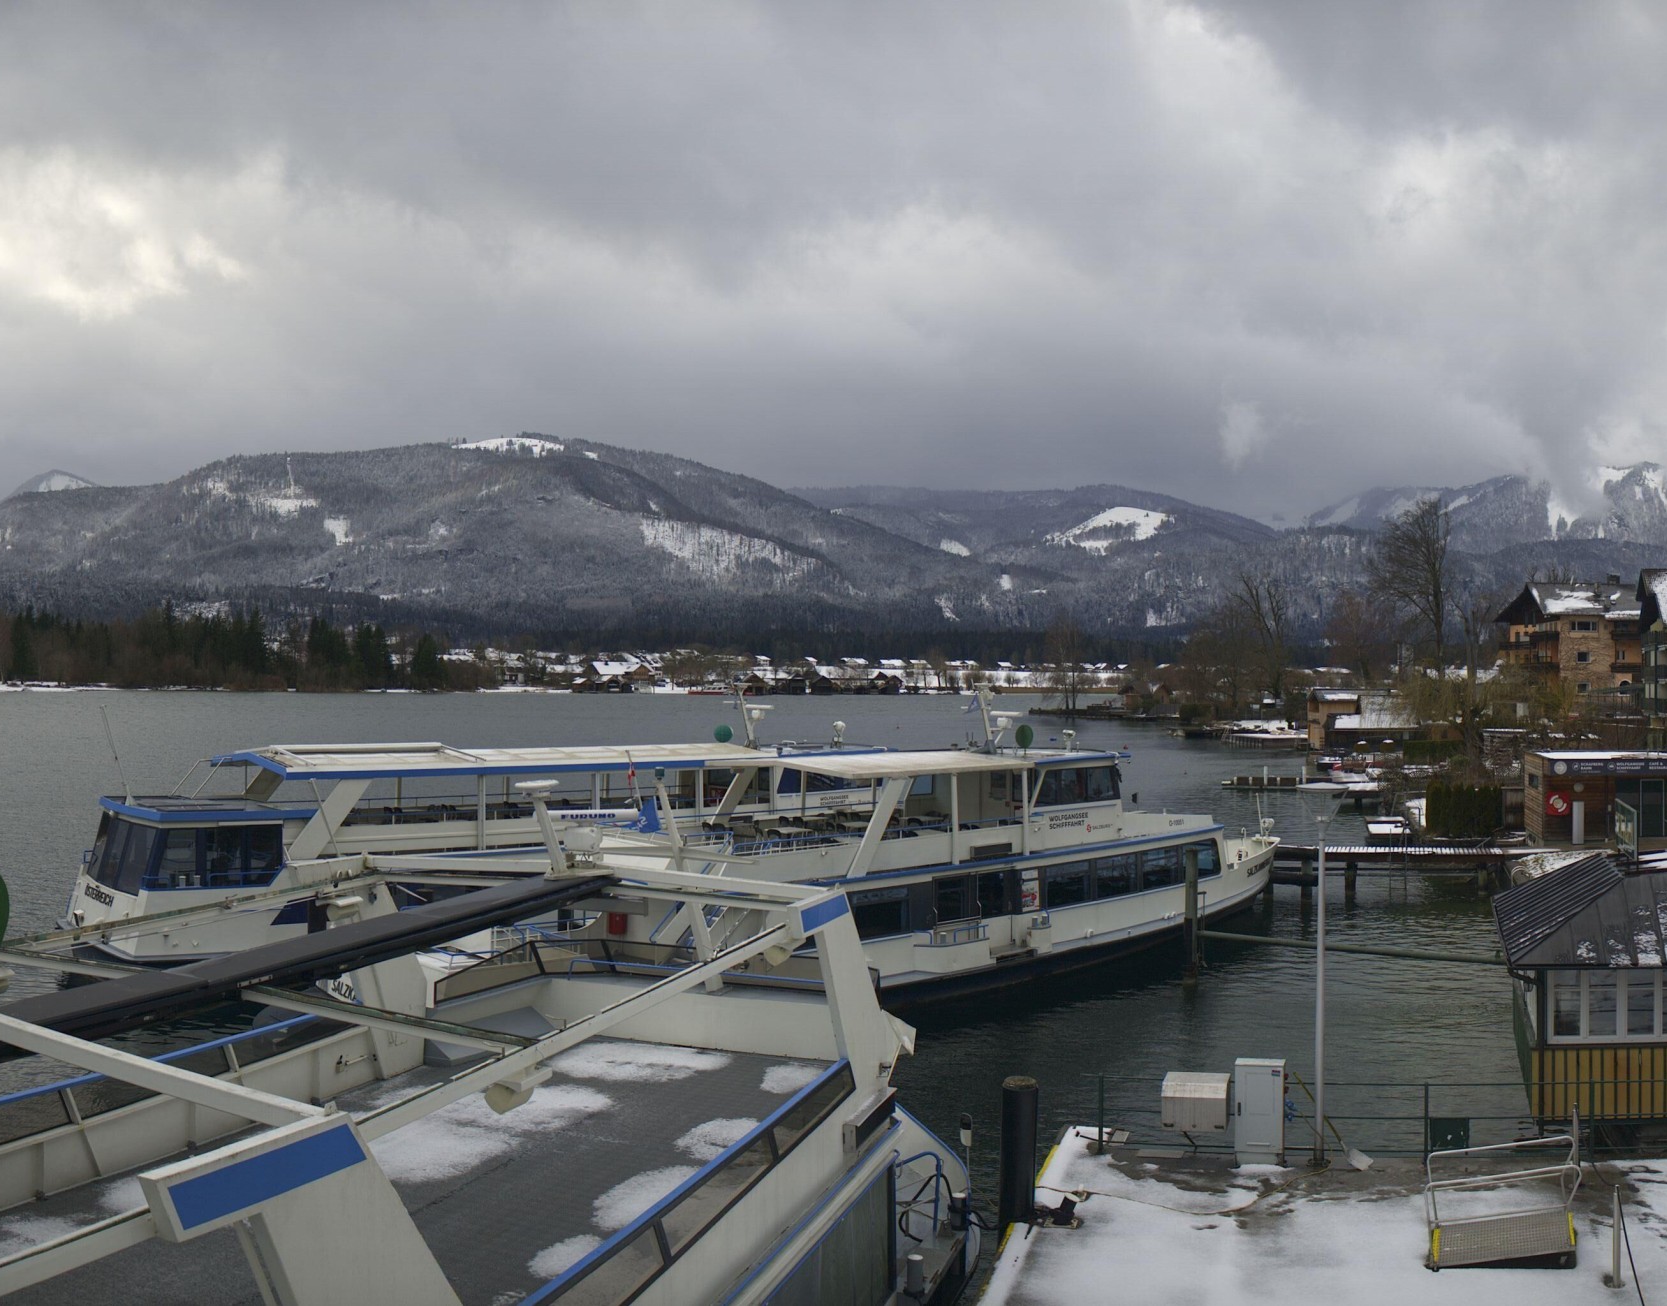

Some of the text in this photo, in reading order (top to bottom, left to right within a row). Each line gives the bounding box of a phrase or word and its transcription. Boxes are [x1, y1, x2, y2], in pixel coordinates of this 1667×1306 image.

[1049, 812, 1089, 822] WOLFGANGSEE
[1049, 819, 1085, 830] SCHIFFFAHRT
[84, 883, 115, 907] ÖSTERREICH
